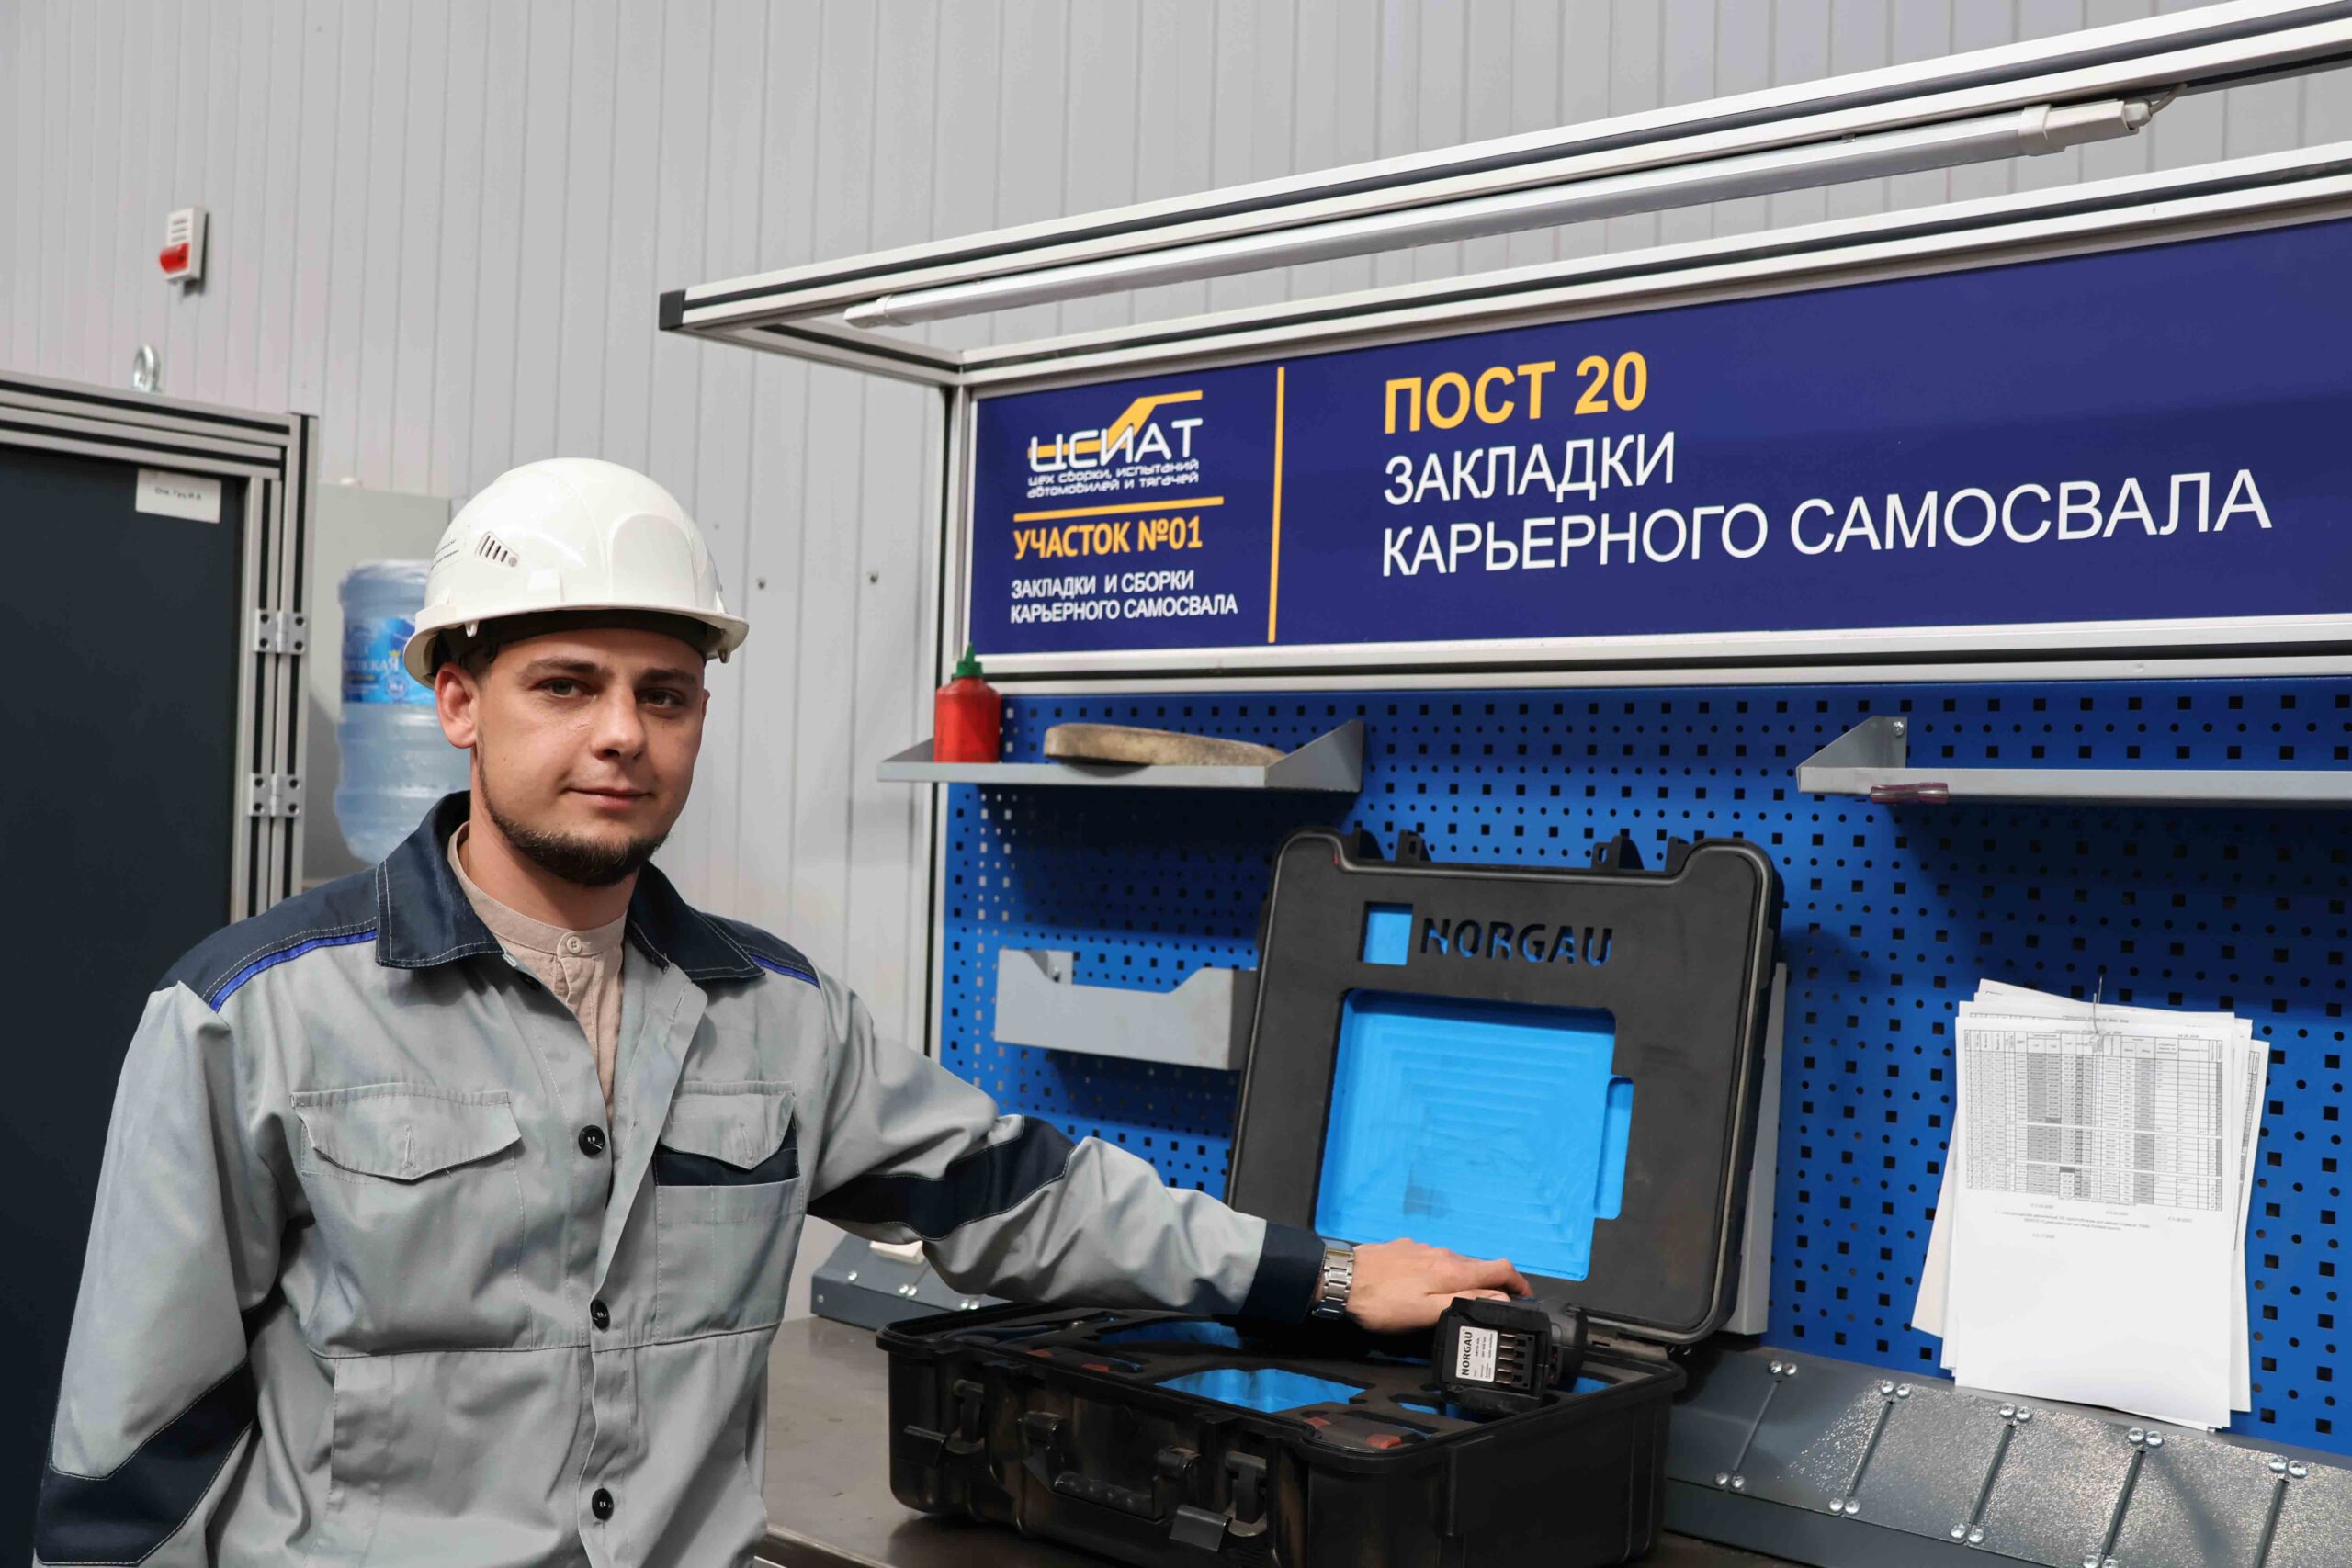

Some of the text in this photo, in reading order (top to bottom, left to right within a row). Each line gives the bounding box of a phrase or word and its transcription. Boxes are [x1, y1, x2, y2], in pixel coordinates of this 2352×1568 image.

[1384, 351, 1648, 434] ПОСТ 20
[1030, 417, 1204, 473] ЦСИАТ
[1026, 471, 1200, 499] автомобилей и тягачей
[1028, 474, 1055, 487] цех
[1115, 458, 1200, 478] испытаний
[1384, 431, 1675, 506] ЗАКЛАДКИ
[1013, 515, 1204, 560] УЧАСТОК №01
[1383, 468, 2273, 577] КАРЬЕРНОГО САМОСВАЛА
[1011, 570, 1195, 600] ЗАКЛАДКИ И СБОРКИ
[1011, 593, 1238, 624] КАРЬЕРНОГО САМОСВАЛА
[1420, 918, 1613, 966] NORGAU
[1461, 1331, 1473, 1376] NORGAU
